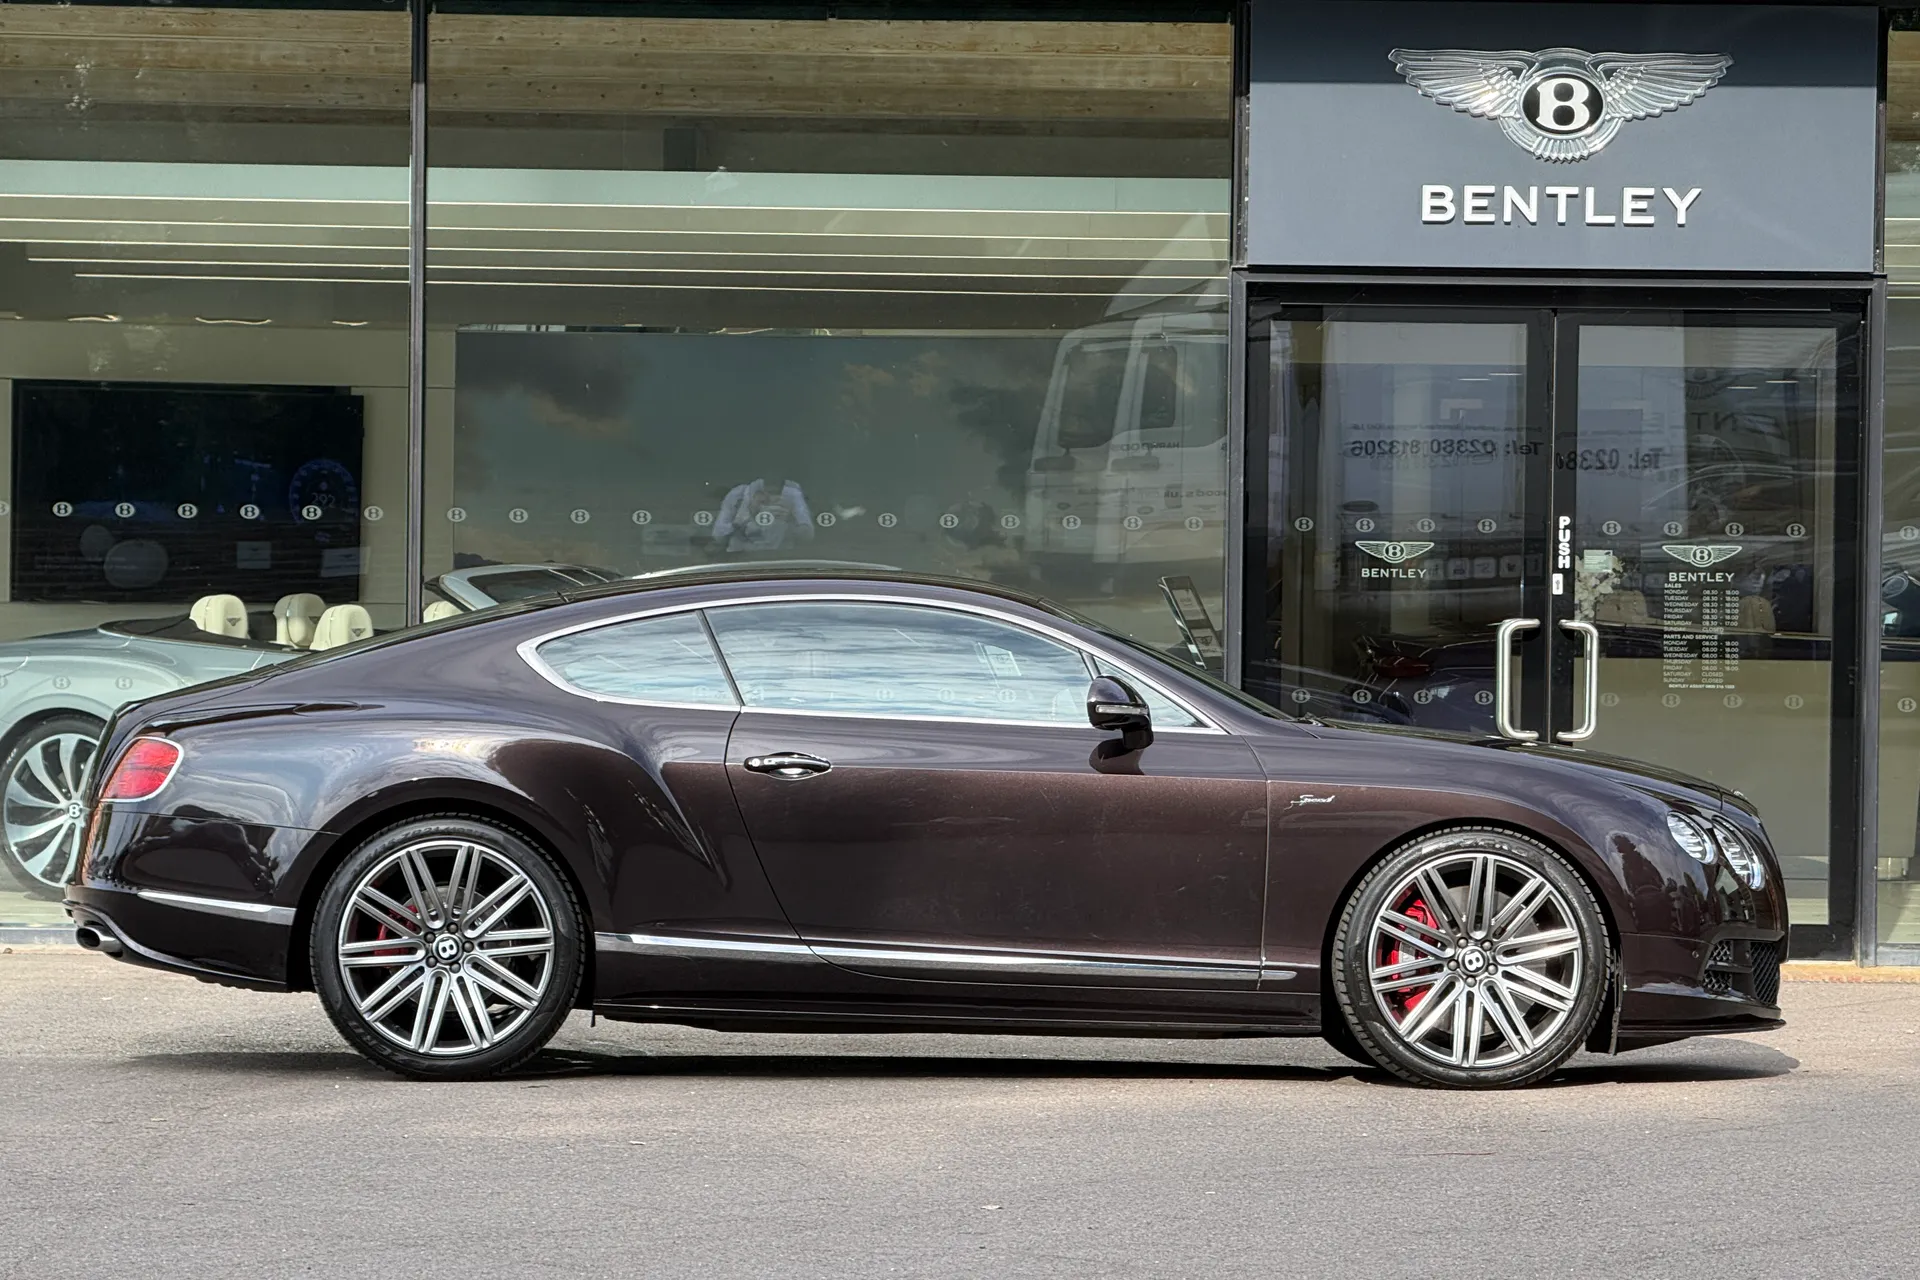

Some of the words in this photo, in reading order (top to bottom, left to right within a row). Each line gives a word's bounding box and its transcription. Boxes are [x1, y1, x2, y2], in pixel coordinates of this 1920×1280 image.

[1536, 77, 1590, 130] B
[1421, 184, 1702, 226] BENTLEY
[1388, 545, 1400, 558] B
[1558, 516, 1571, 570] PUSH
[1696, 550, 1708, 560] B
[1361, 568, 1428, 578] BENTLEY
[1668, 572, 1735, 582] BENTLEY
[1284, 795, 1336, 810] Speed
[438, 939, 457, 958] B
[1464, 951, 1484, 971] B
